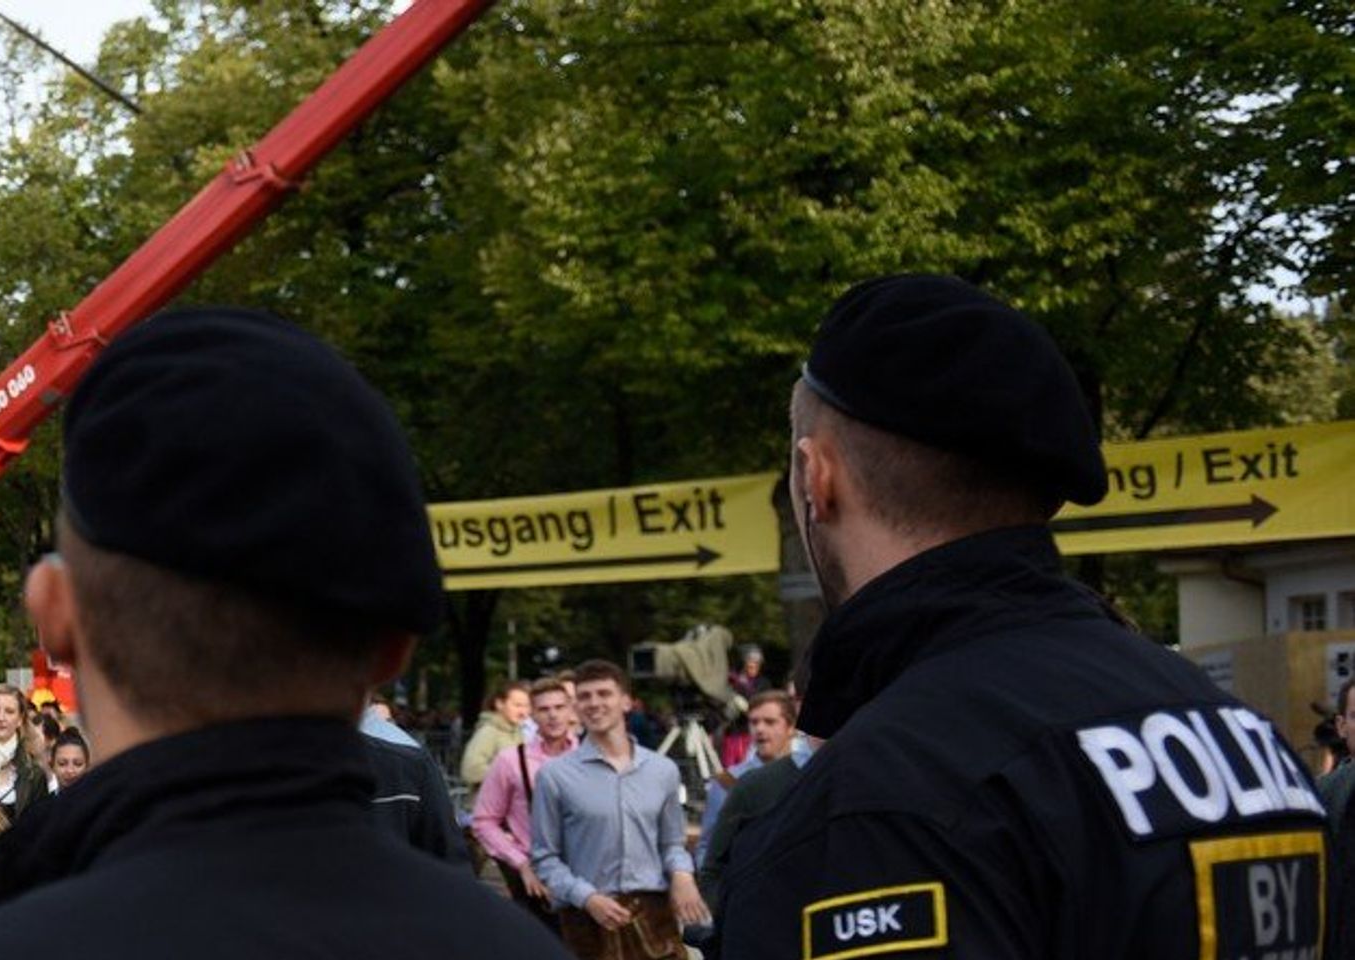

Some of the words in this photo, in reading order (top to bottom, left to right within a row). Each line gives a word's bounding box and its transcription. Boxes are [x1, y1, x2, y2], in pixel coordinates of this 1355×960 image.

[1106, 464, 1158, 500] ng
[1174, 451, 1184, 490] /
[1200, 441, 1300, 486] Exit
[434, 509, 596, 557] usgang
[608, 495, 618, 539] /
[632, 486, 727, 535] Exit
[1076, 707, 1328, 835] POLIZ
[833, 904, 902, 942] USK
[1248, 861, 1300, 946] BY
